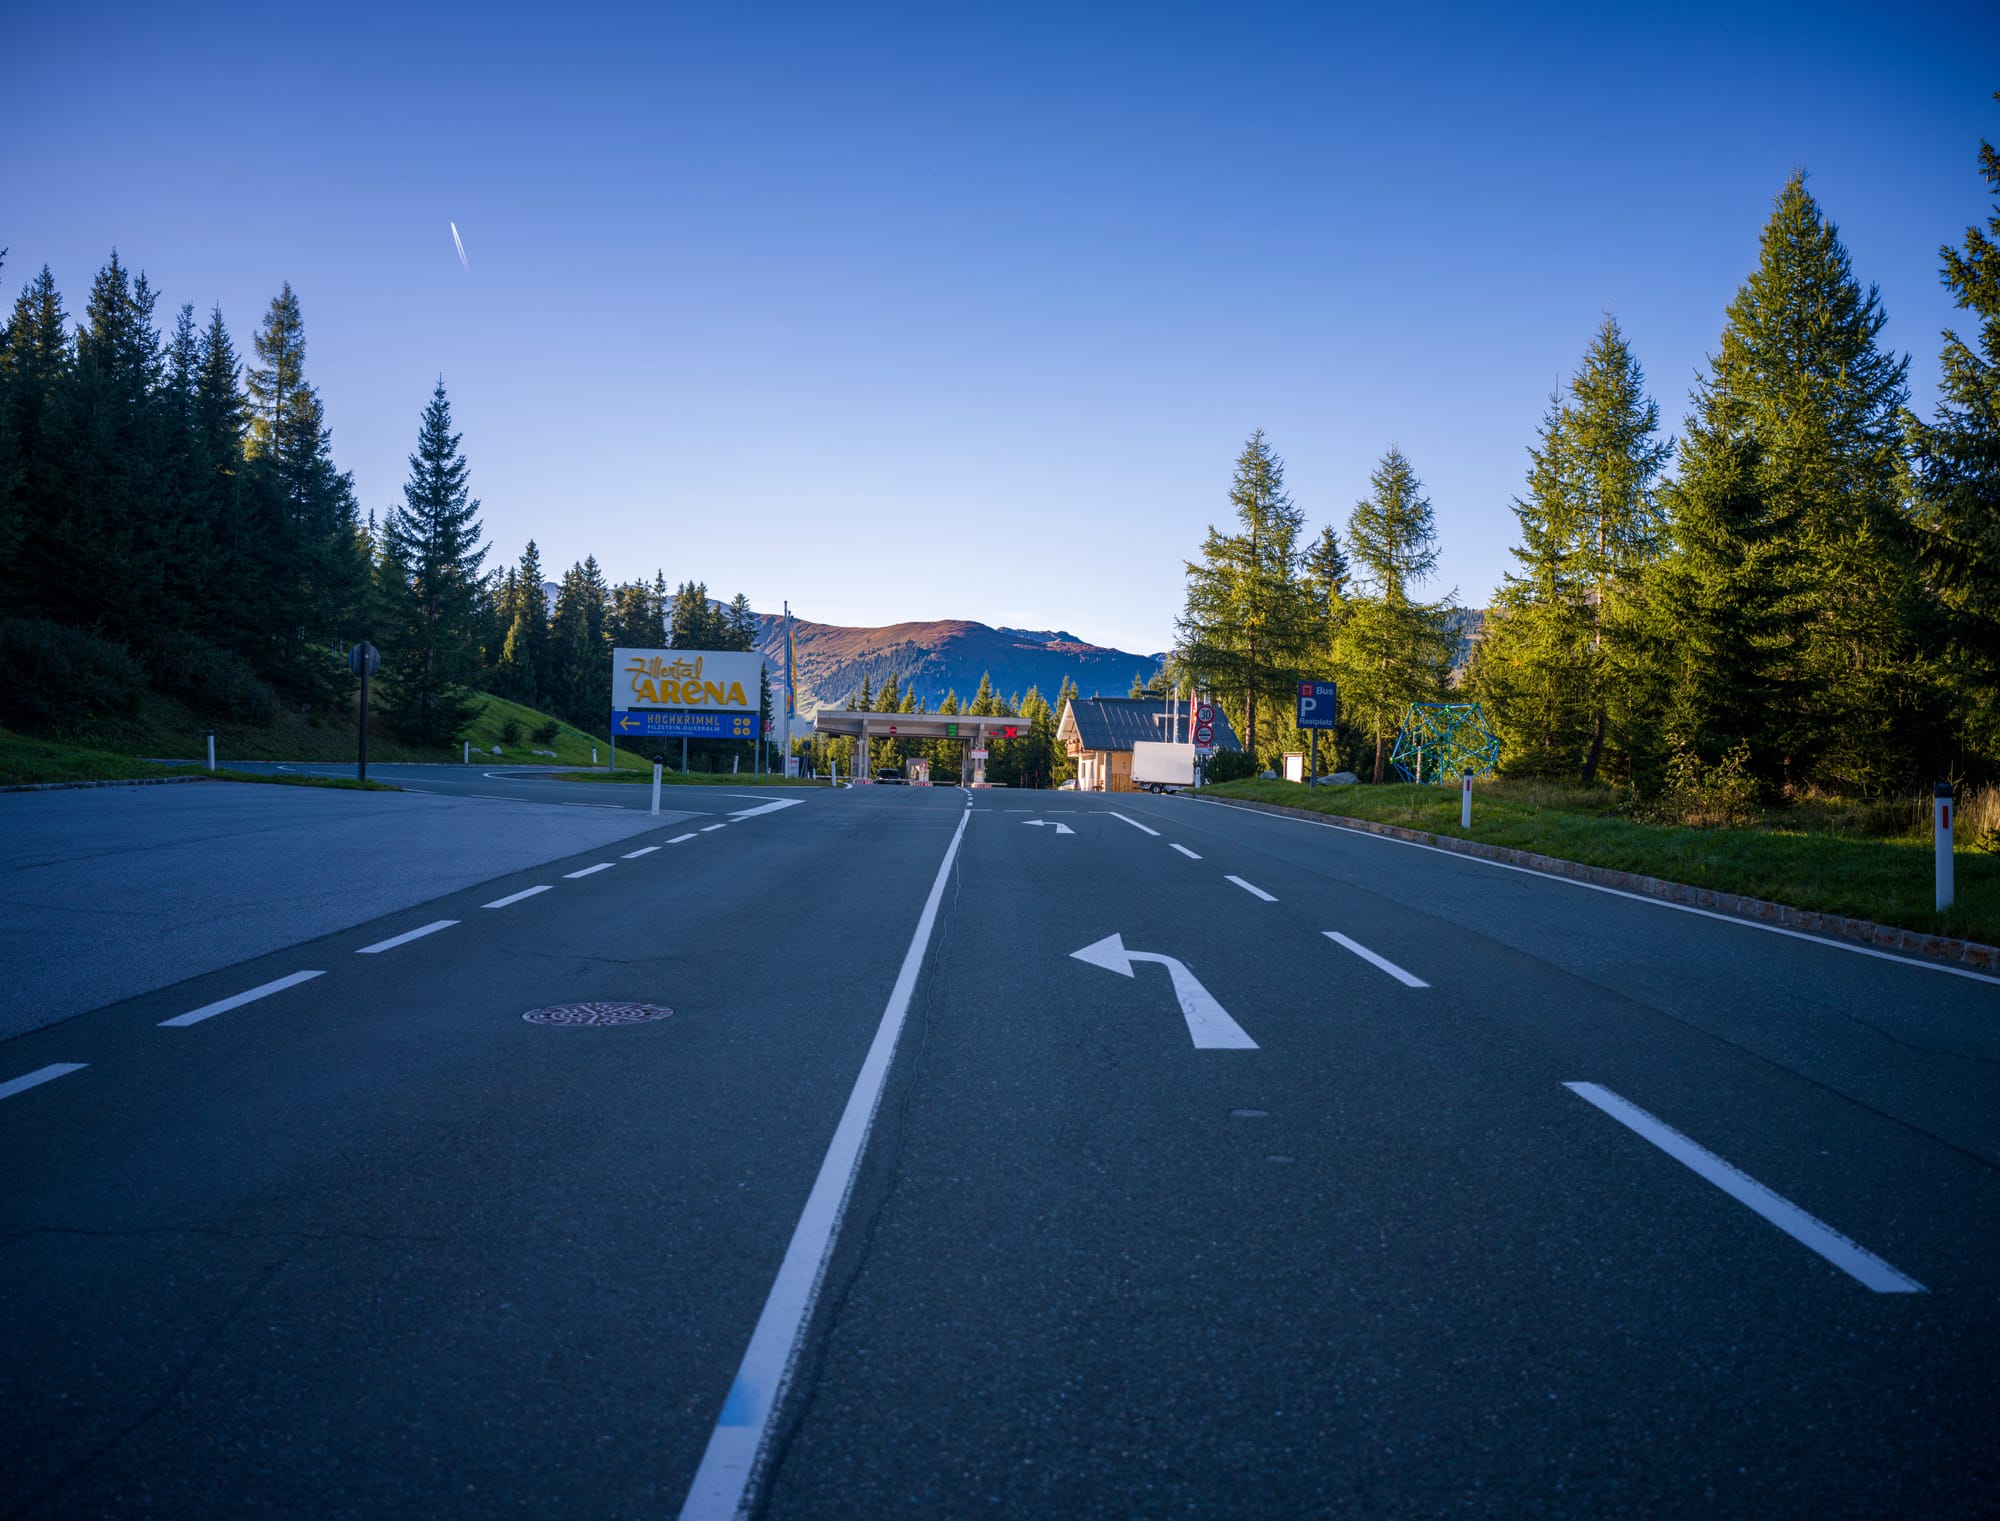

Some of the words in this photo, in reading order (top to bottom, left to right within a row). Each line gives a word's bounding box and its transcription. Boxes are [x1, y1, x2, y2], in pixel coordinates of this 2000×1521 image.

[624, 656, 703, 690] Zillertal
[1316, 686, 1334, 695] Bus
[1301, 697, 1317, 717] P
[647, 714, 721, 727] HOCHKRIMML
[1200, 709, 1211, 720] 30
[1299, 717, 1333, 727] Rastplatz
